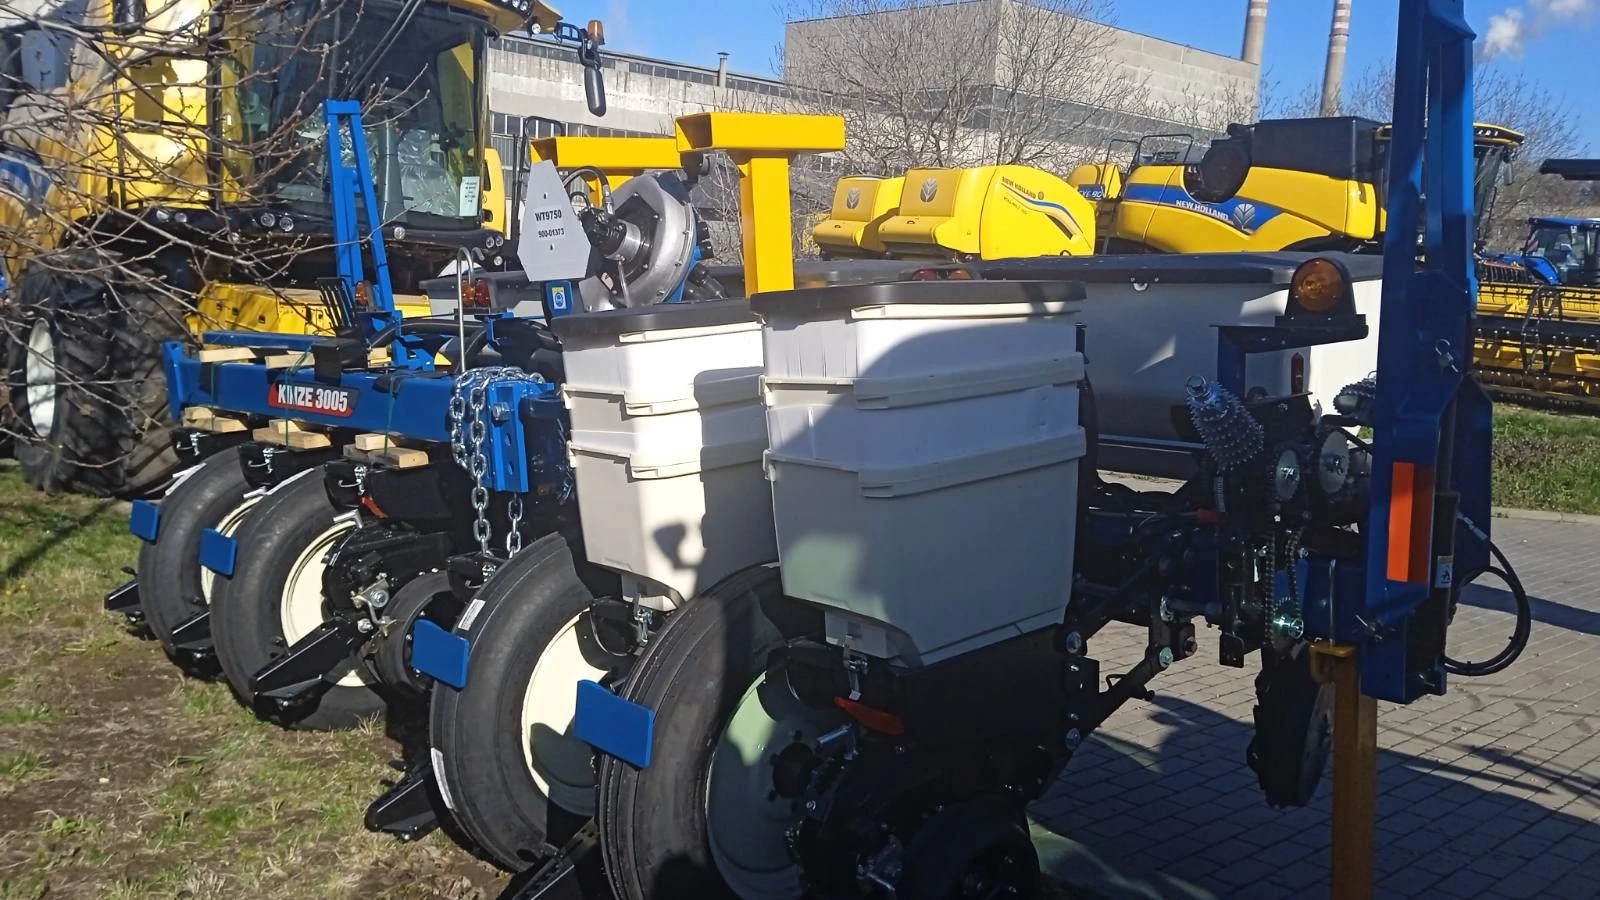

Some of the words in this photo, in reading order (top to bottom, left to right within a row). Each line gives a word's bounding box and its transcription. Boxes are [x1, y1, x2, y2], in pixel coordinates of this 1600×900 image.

[534, 209, 562, 222] WT9750
[1175, 199, 1194, 209] NEW
[1194, 203, 1229, 221] HOLLAND
[277, 383, 315, 408] KINZE
[314, 388, 349, 413] 3005
